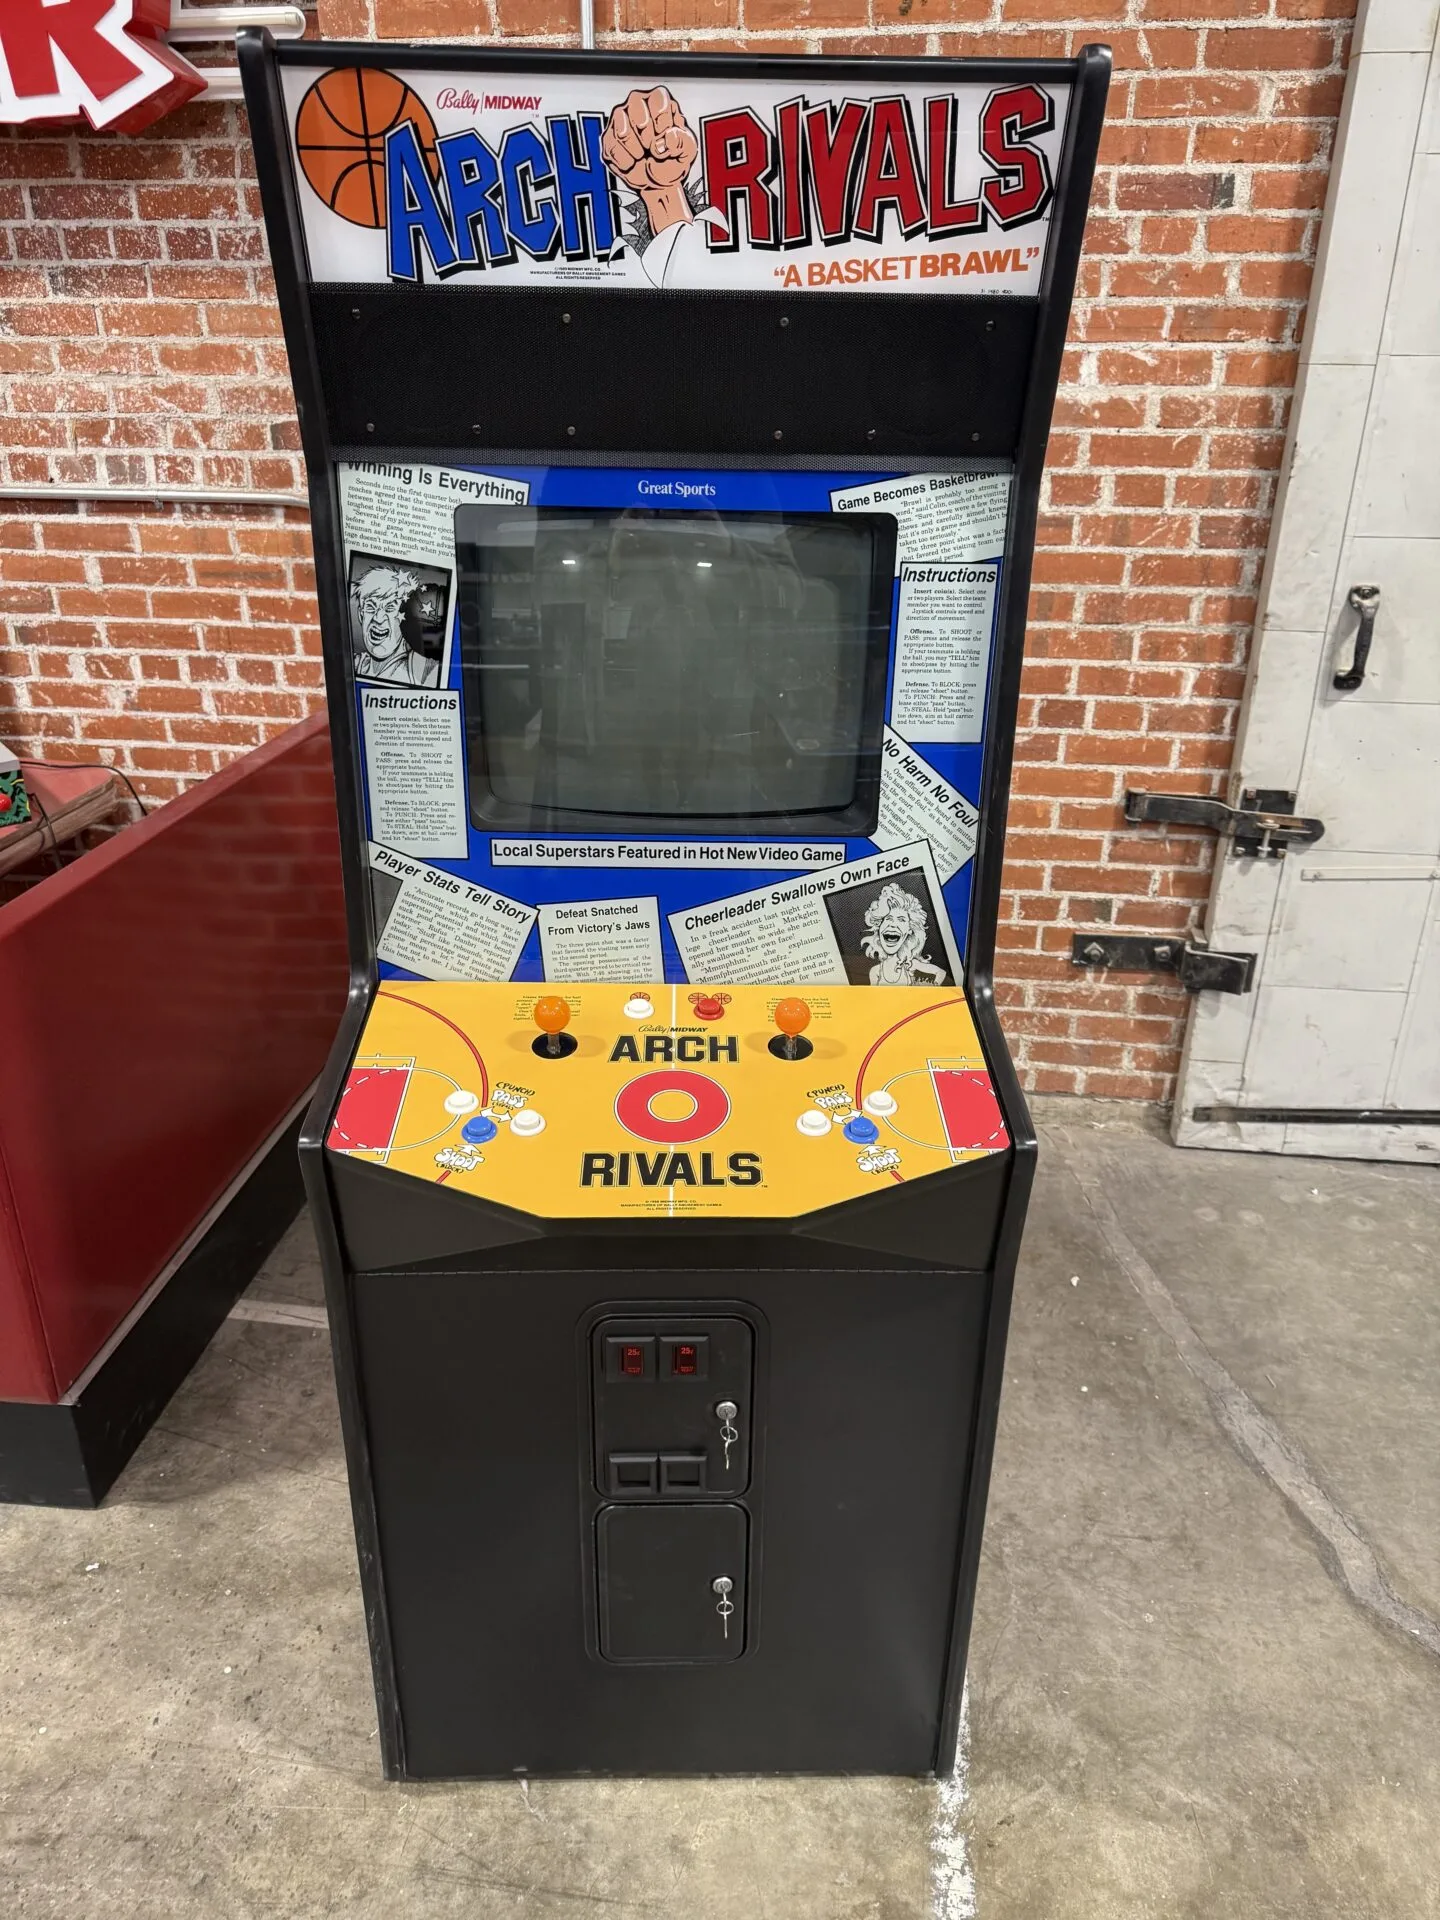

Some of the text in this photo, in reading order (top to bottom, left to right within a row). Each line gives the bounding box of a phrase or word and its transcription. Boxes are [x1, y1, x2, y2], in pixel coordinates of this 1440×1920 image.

[436, 87, 542, 115] Bally MIDWAY
[385, 82, 1055, 284] ARCH RIVALS
[356, 477, 380, 489] Seconds
[382, 484, 396, 492] into
[396, 486, 407, 494] the
[408, 488, 422, 497] first
[423, 493, 448, 502] quarter
[419, 468, 432, 485] Is
[439, 472, 525, 505] Everything
[637, 479, 716, 498] Great Sports
[838, 496, 870, 511] Game
[873, 484, 926, 503] Becomes
[900, 497, 922, 507] "Brawl
[935, 490, 962, 502] probably
[978, 483, 998, 491] strong
[903, 567, 996, 583] Instructions
[365, 694, 456, 710] Instructions
[882, 738, 980, 828] No Harm No Foul
[893, 768, 979, 846] One official was heard to mutter,
[494, 843, 843, 861] Local Superstars Featured in Hot New Video Game
[374, 850, 531, 924] Player Stats Tell Story
[685, 856, 909, 930] Cheerleader Swallows Own Face
[403, 891, 519, 942] determining which players have
[414, 886, 445, 903] "Accurate
[446, 901, 469, 914] records
[485, 916, 500, 927] long
[500, 924, 514, 933] way
[555, 904, 638, 919] Defeat Snatched
[709, 926, 729, 937] freak
[731, 917, 762, 931] accident
[763, 912, 778, 921] last
[780, 906, 801, 916] night
[803, 900, 816, 909] col-
[548, 921, 650, 936] From Victory's Jaws
[685, 910, 819, 953] lege cheerleader Suzi Markglen
[688, 948, 714, 962] opened
[715, 945, 729, 953] her
[731, 936, 756, 949] mouth
[767, 928, 785, 938] wide
[787, 924, 800, 932] she
[802, 919, 821, 928] actu-
[691, 933, 795, 969] ally swallowed her own face!
[763, 949, 776, 957] she
[788, 933, 824, 949] explained
[736, 951, 830, 982] enthusiastic fans attemp-
[780, 968, 800, 978] cheer
[802, 961, 817, 971] and
[813, 967, 835, 977] minor
[607, 1034, 740, 1063] ARCH
[491, 1089, 528, 1108] PASS
[496, 1082, 535, 1096] (PUNCH)
[807, 1084, 845, 1099] (PUNCH)
[814, 1091, 853, 1109] PASS
[434, 1148, 485, 1171] SHOOT
[579, 1151, 763, 1187] RIVALS
[856, 1148, 902, 1172] SHOOT
